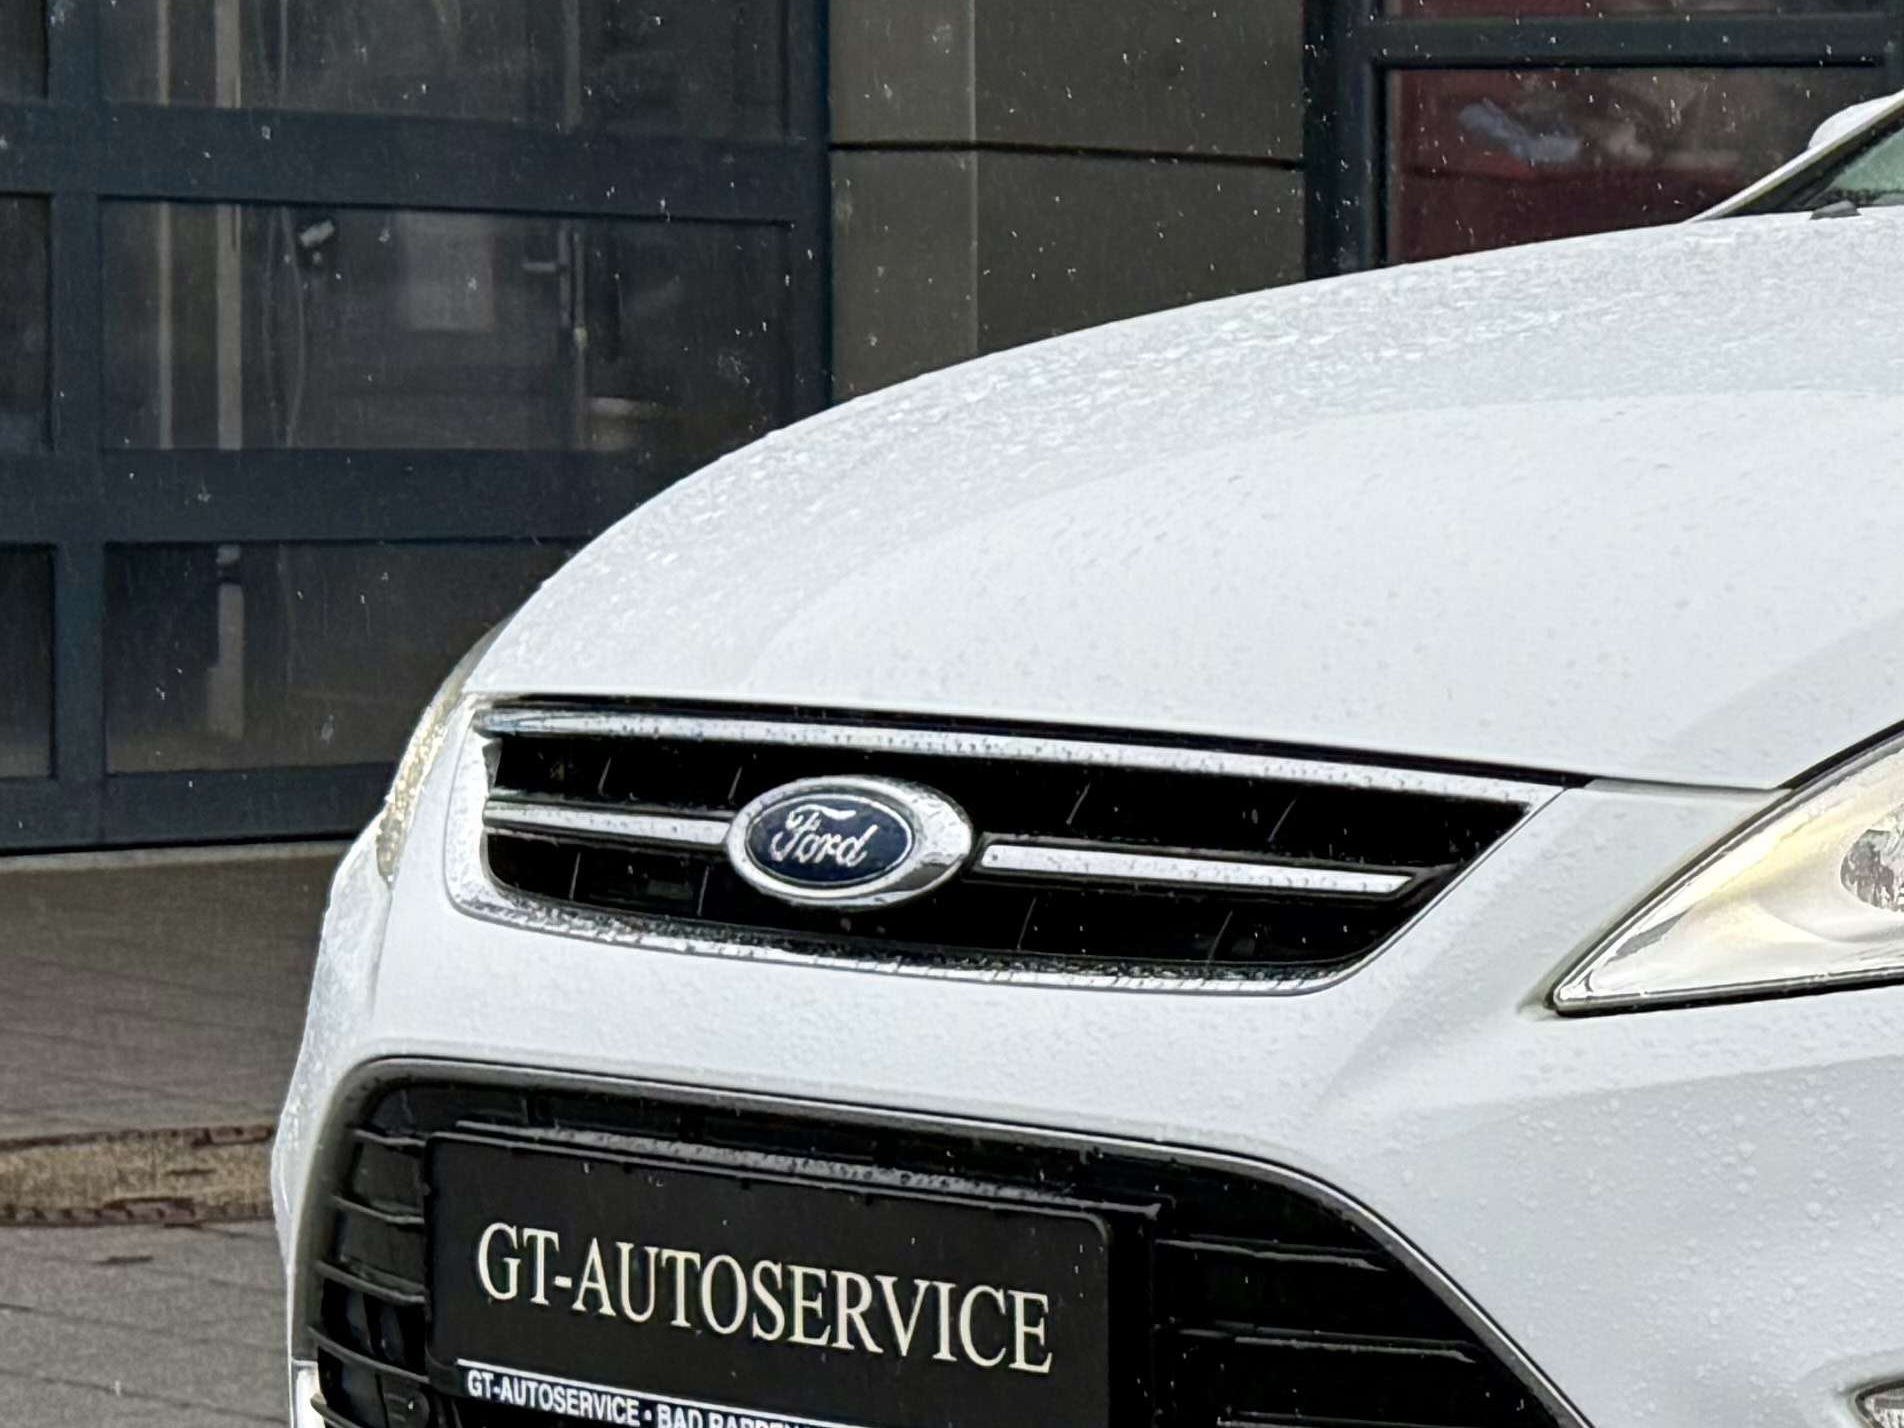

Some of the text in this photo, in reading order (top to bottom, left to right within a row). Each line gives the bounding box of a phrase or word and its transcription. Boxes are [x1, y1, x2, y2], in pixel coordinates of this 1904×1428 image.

[768, 803, 878, 867] Ford
[477, 1222, 1053, 1374] GT-AUTOSERVICE
[466, 1369, 641, 1427] GT-AUTOSERVICE
